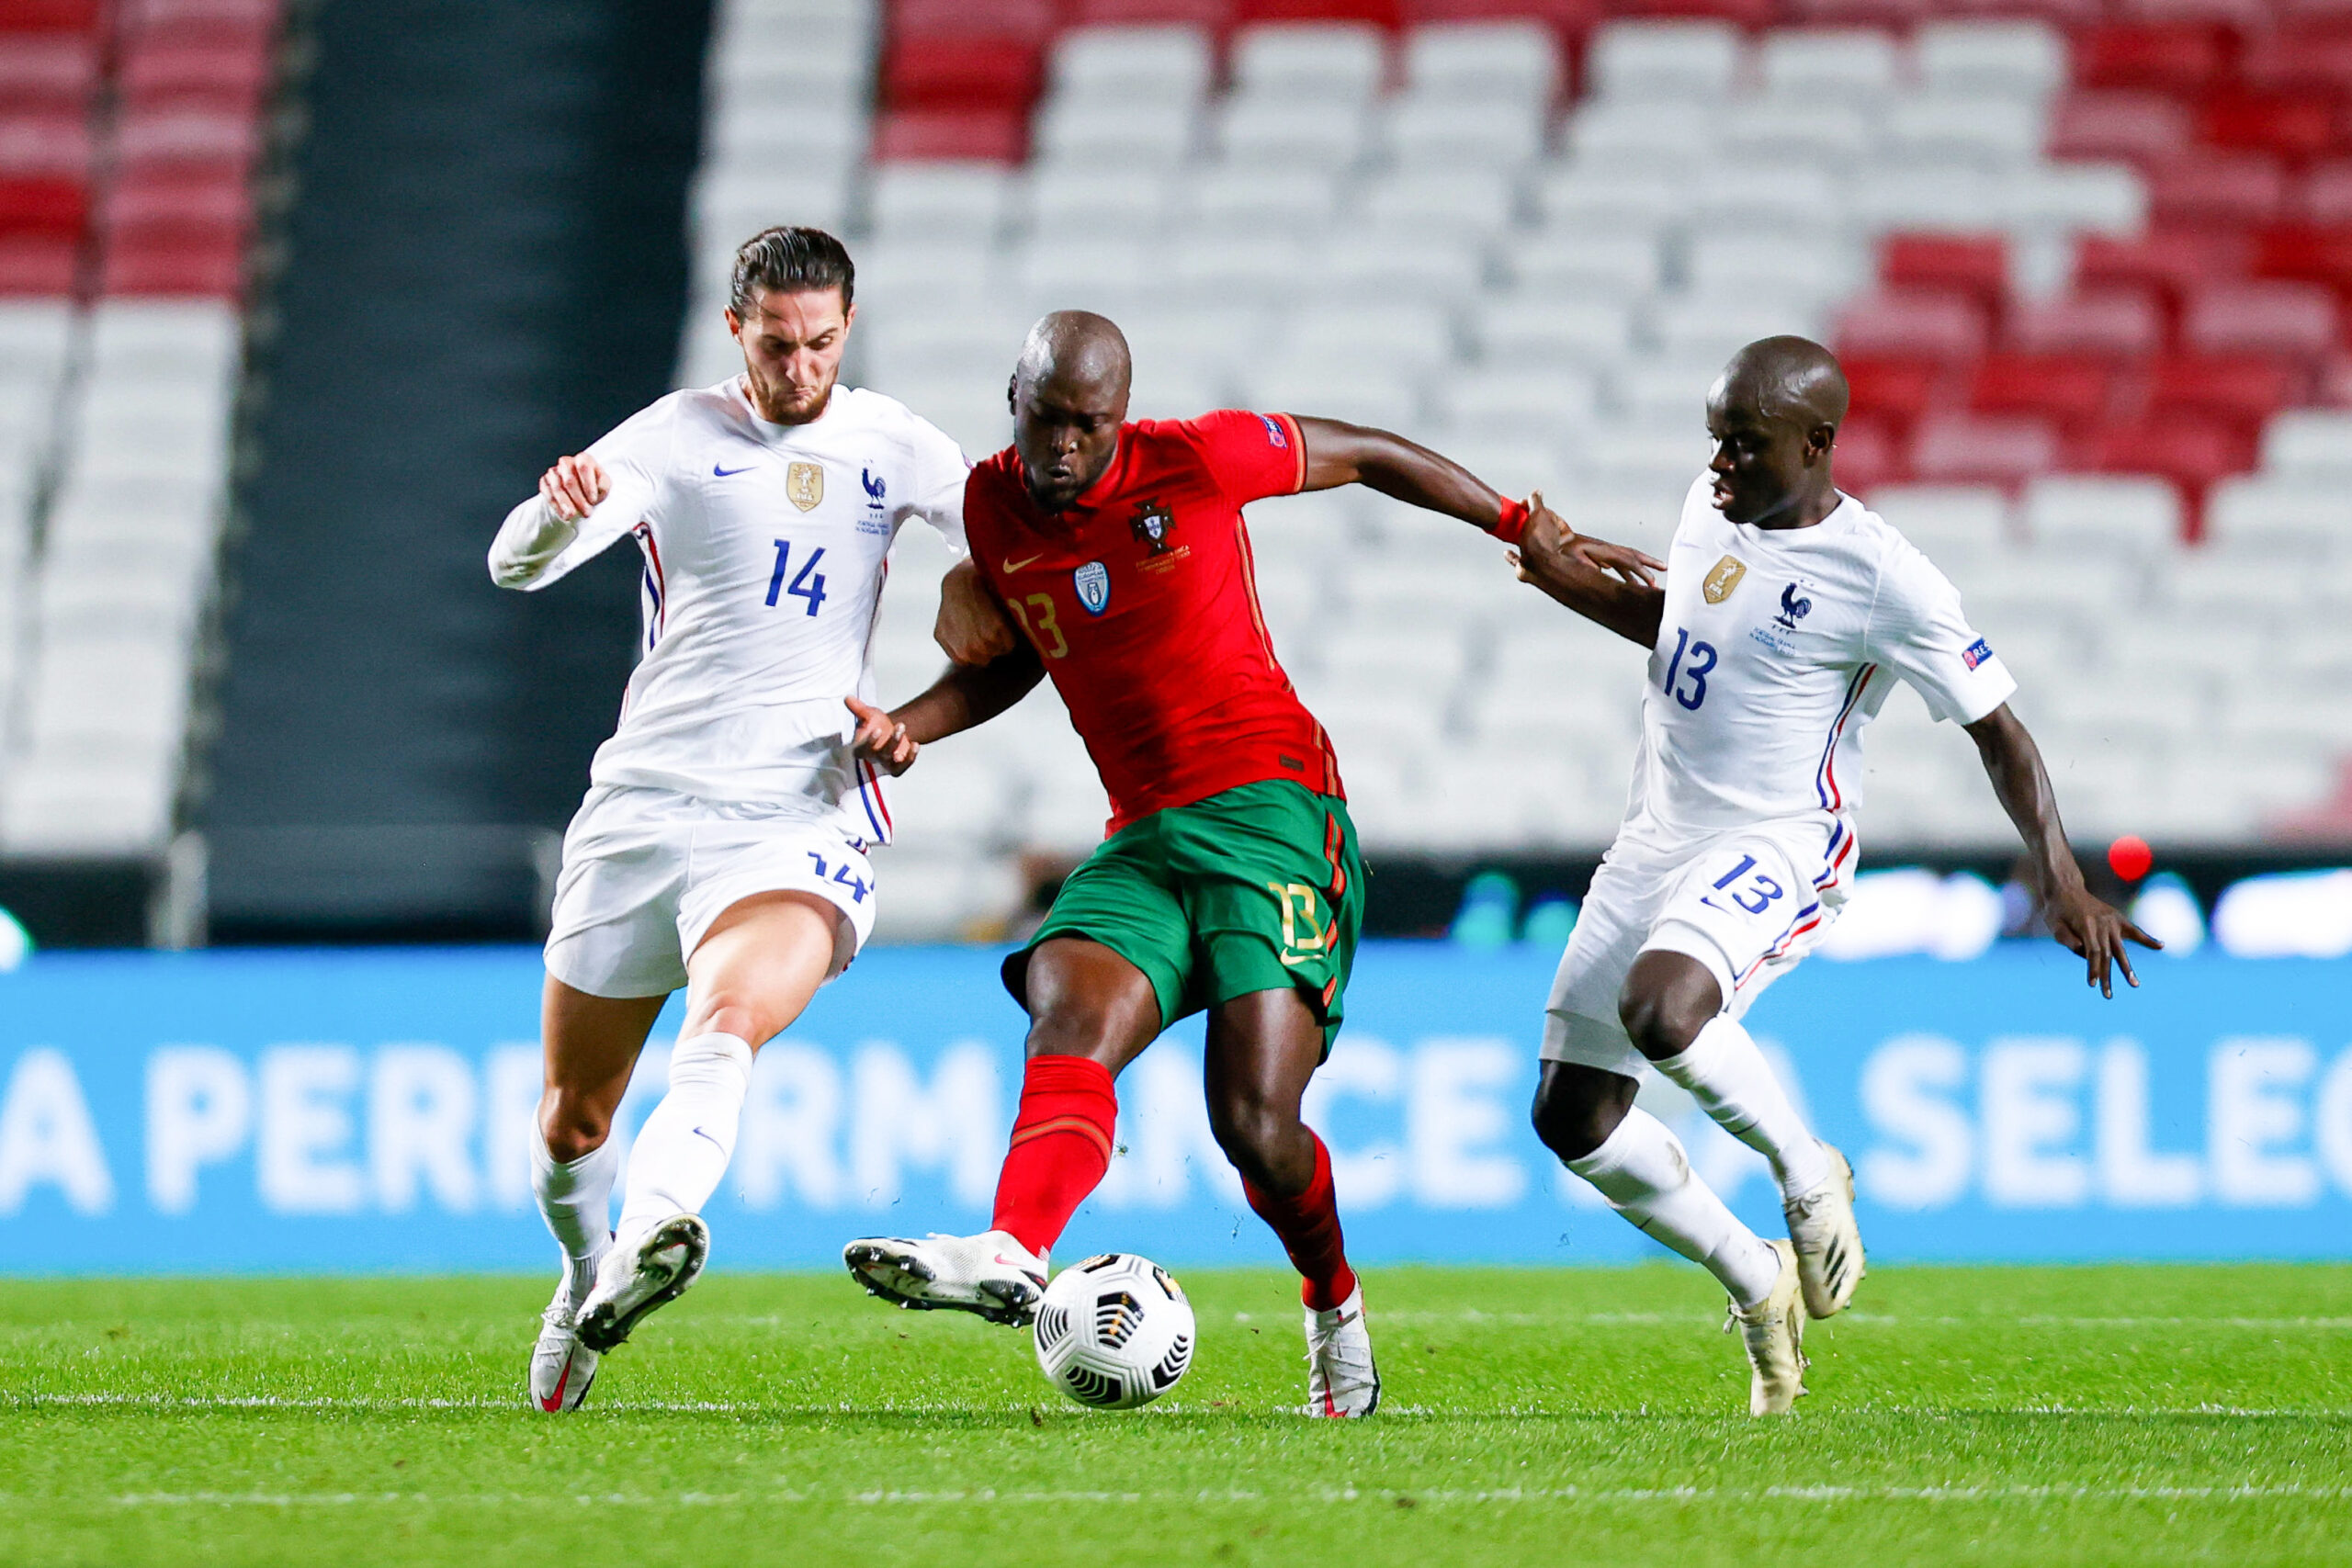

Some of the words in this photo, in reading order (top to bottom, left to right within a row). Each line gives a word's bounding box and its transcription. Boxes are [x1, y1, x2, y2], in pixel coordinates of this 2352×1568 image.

[765, 538, 827, 617] 14
[1008, 592, 1069, 659] 13
[1665, 626, 1718, 711] 13
[808, 851, 869, 904] 14
[1713, 854, 1783, 914] 13
[1268, 882, 1326, 950] 13
[0, 1047, 113, 1214] A
